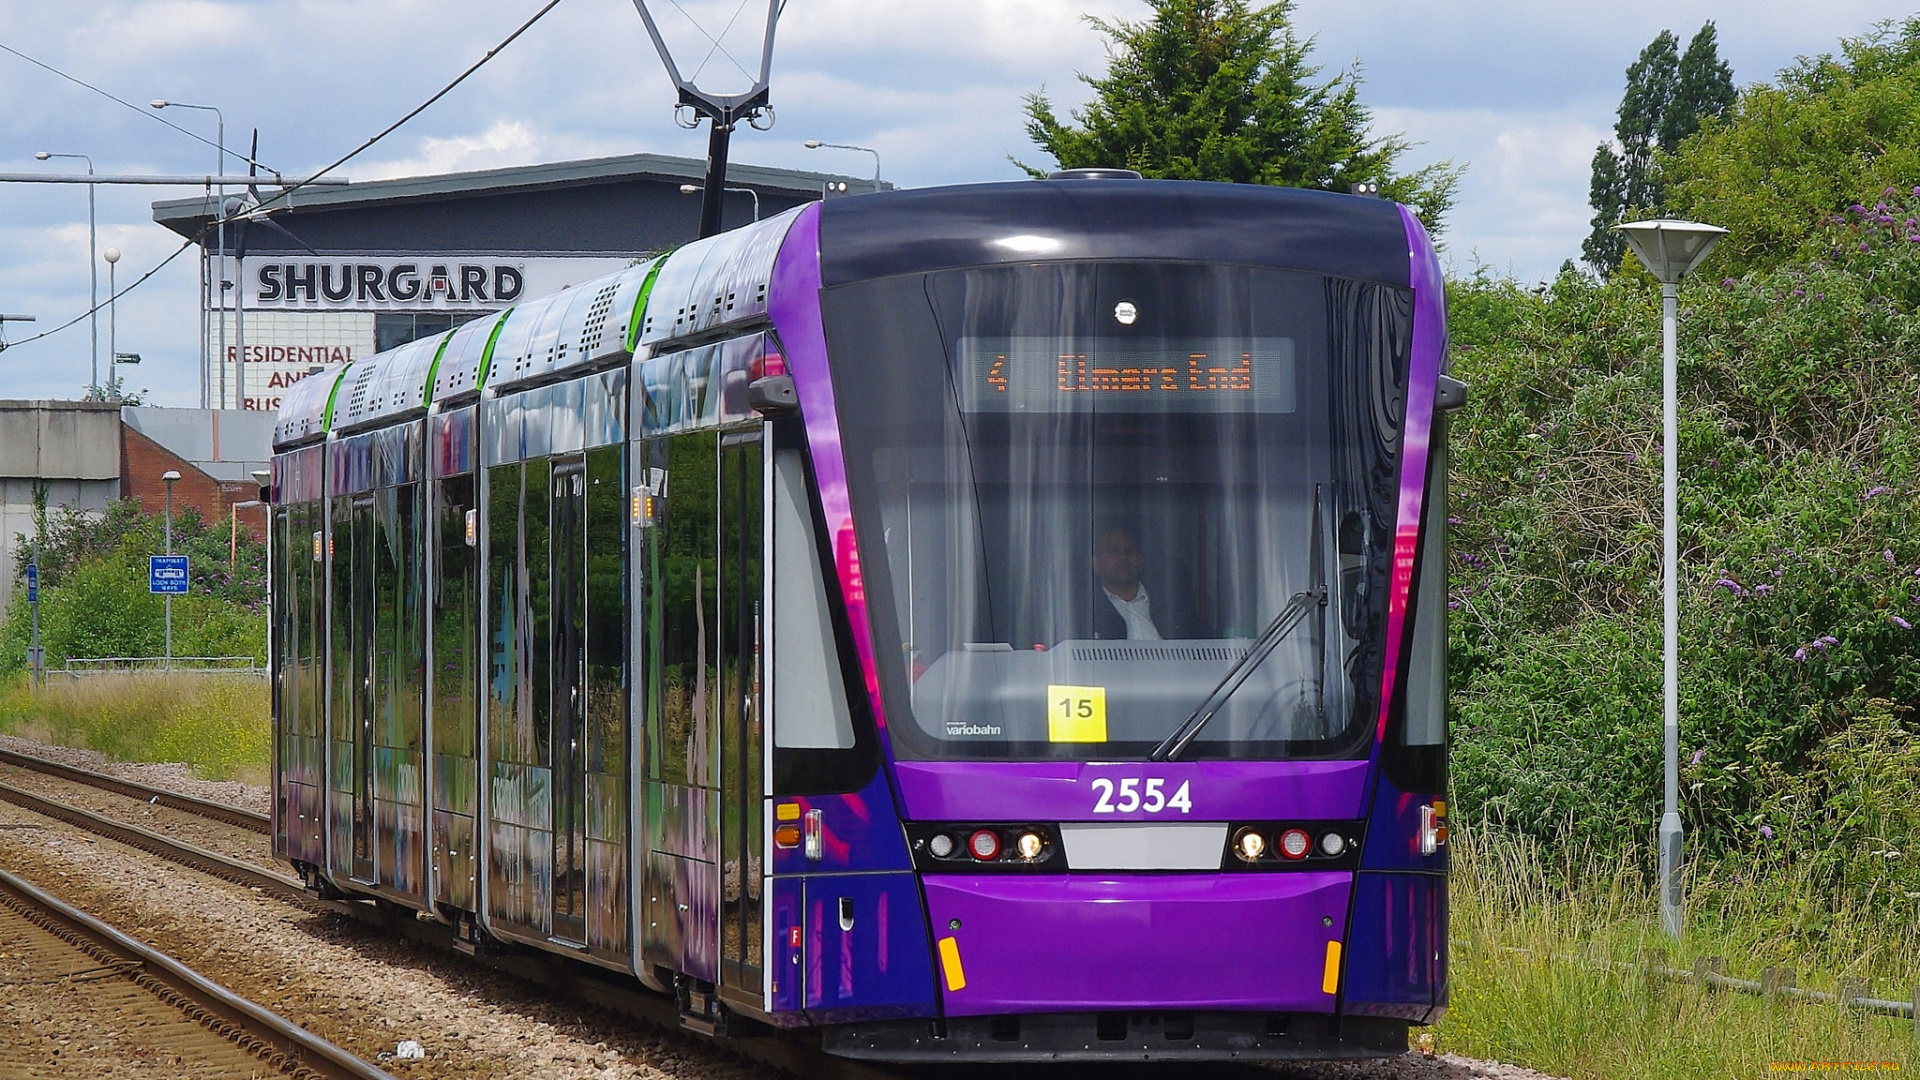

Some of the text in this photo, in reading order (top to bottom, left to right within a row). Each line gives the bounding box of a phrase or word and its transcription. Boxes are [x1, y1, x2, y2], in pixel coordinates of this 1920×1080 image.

[258, 263, 524, 302] SHURGARD
[226, 345, 353, 363] RESIDENTIAL
[268, 371, 310, 388] AN
[988, 355, 1007, 391] 4
[1189, 353, 1250, 390] End
[1059, 698, 1093, 719] 15
[946, 724, 1001, 736] variobahn
[1091, 778, 1193, 814] 2554
